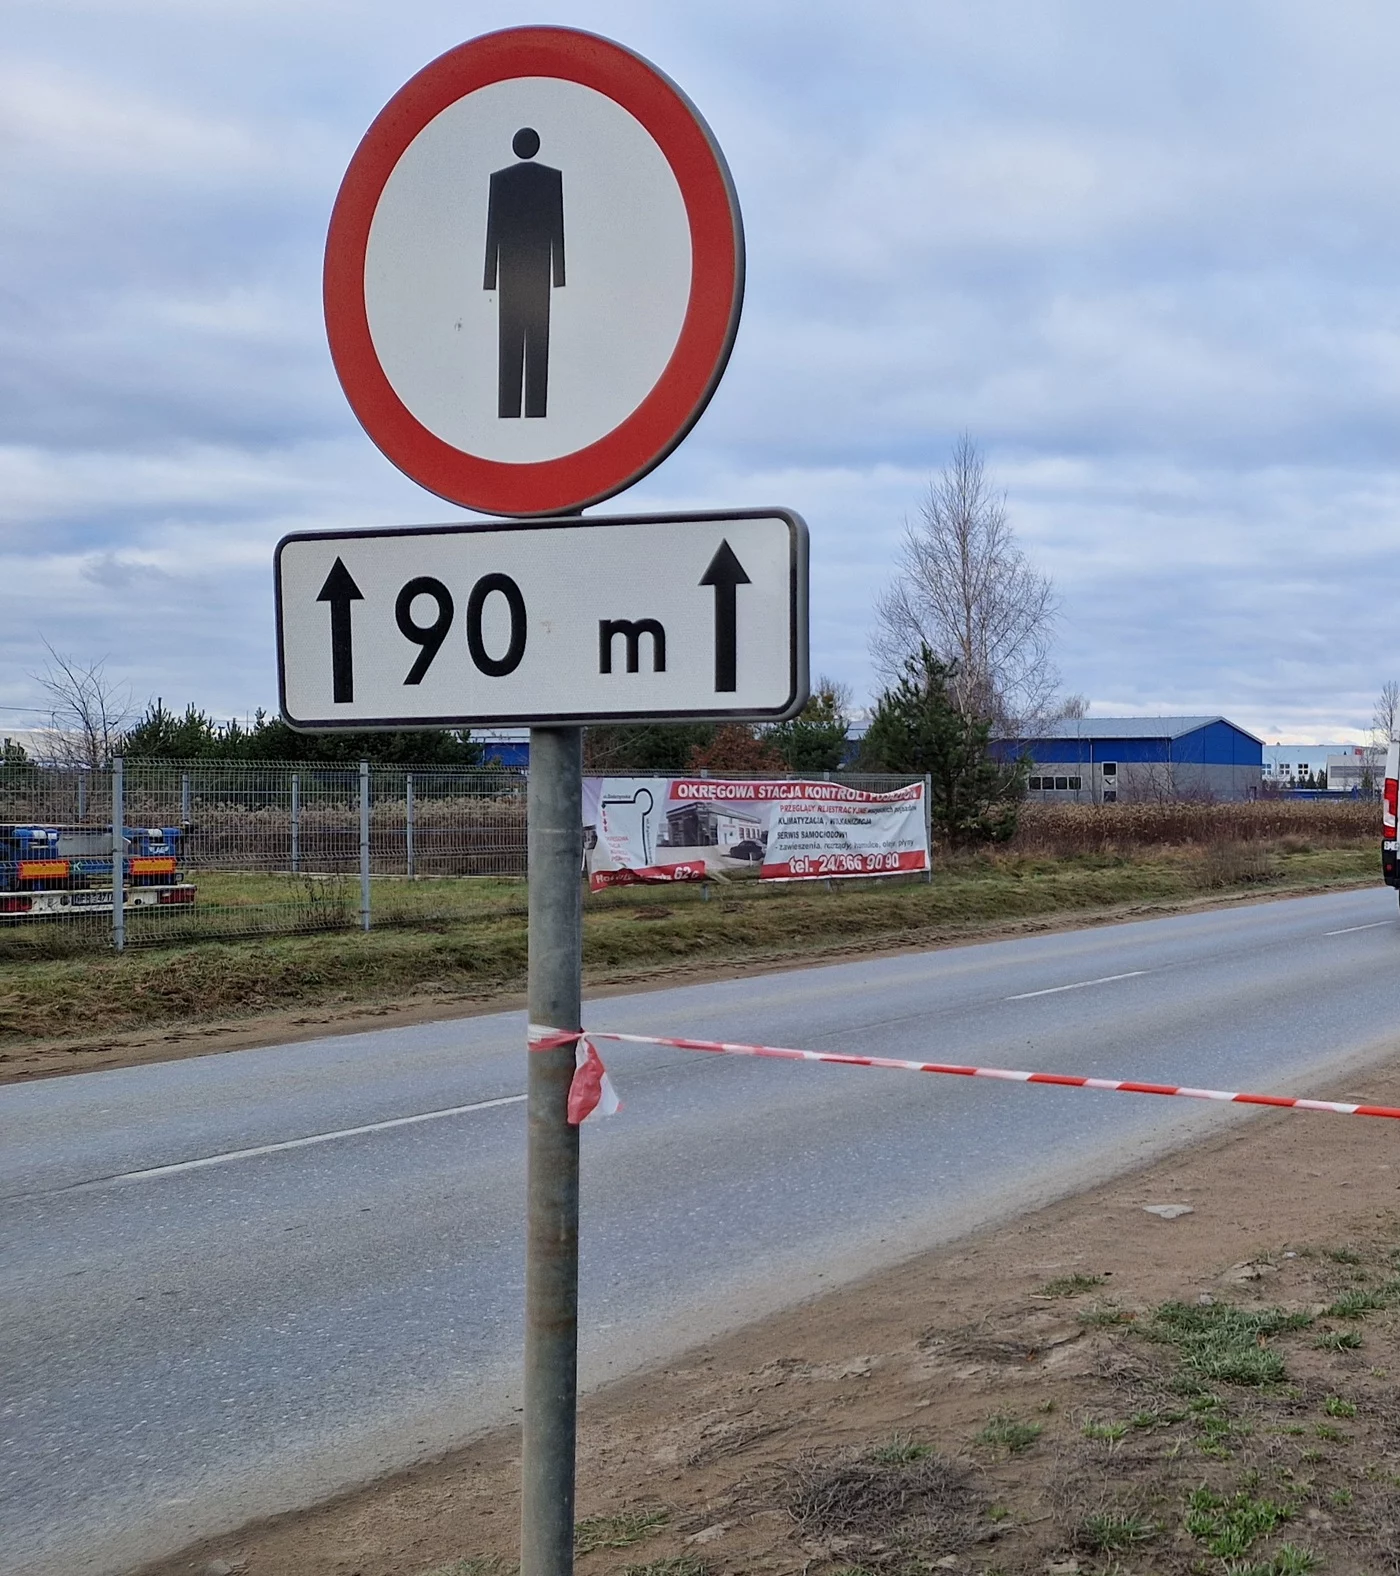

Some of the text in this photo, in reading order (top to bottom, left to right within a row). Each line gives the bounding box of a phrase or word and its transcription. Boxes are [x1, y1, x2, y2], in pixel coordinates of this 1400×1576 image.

[395, 572, 667, 686] 90 m
[677, 784, 755, 800] OKRĘGOWA
[758, 785, 801, 799] STACJA
[804, 786, 866, 801] KONTROLI
[778, 816, 824, 825] KLIMATYZACJA
[777, 831, 799, 840] SERWIS
[789, 852, 900, 874] tel. 24/366 90 90
[674, 866, 692, 880] 62
